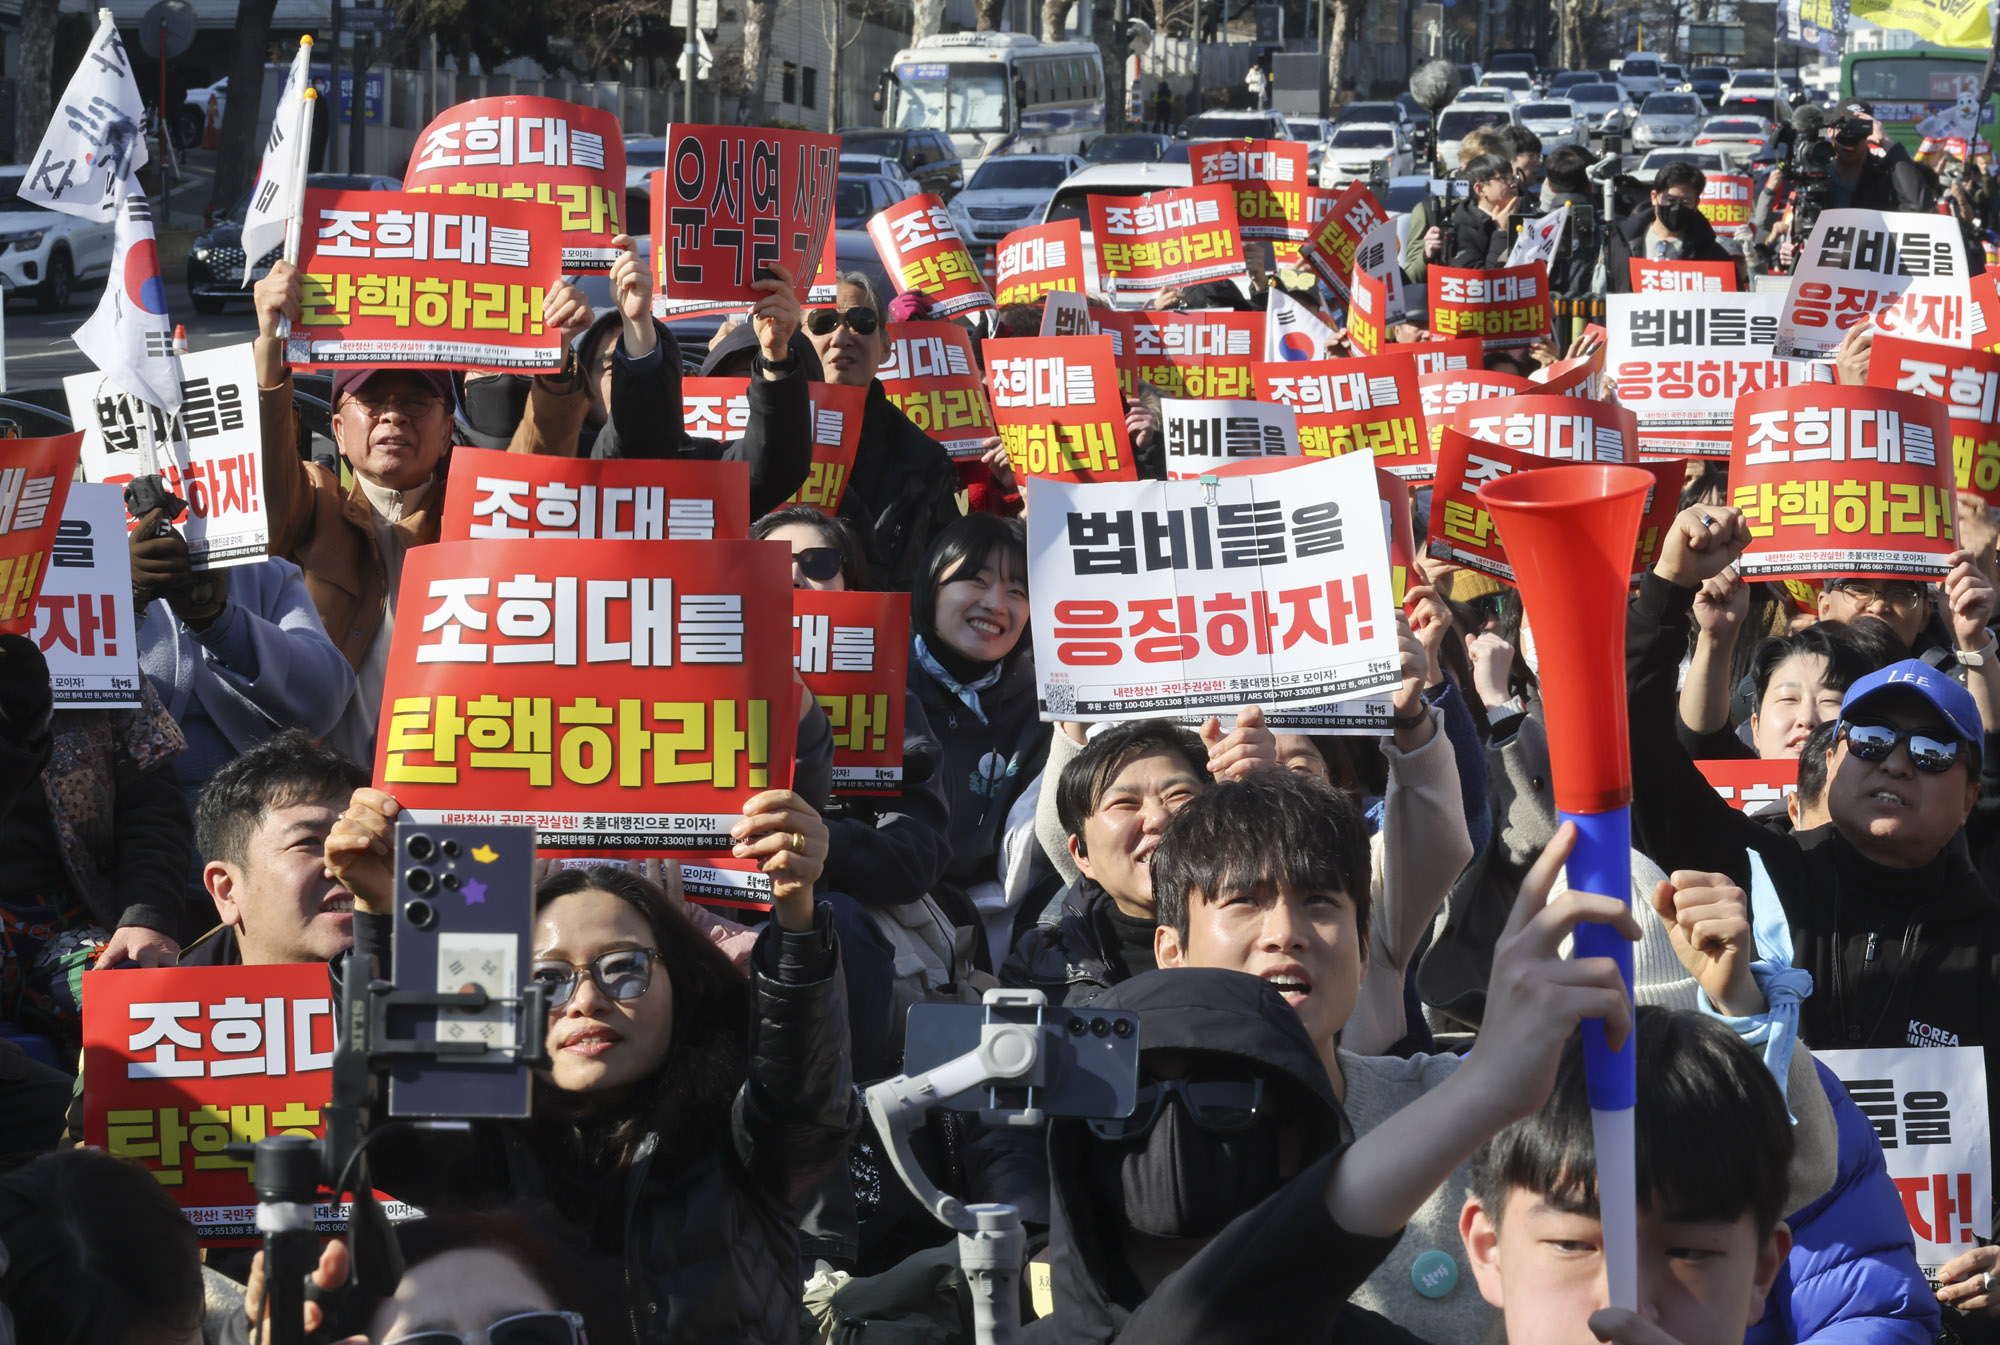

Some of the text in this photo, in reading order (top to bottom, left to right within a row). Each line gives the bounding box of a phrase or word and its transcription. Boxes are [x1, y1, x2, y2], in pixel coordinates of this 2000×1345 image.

[416, 116, 605, 170] 조희대를
[1201, 152, 1294, 184] 조희대를
[1233, 190, 1300, 222] 하라!
[1698, 181, 1748, 200] 희대를
[671, 136, 781, 287] 윤석열
[1105, 198, 1220, 235] 조희대를
[316, 209, 530, 267] 조희대를
[1103, 229, 1234, 272] 탄핵하라!
[1817, 226, 1954, 277] 법비들을
[301, 273, 544, 335] 탄핵하라!
[1441, 276, 1537, 303] 조희대를
[1434, 304, 1545, 336] 탄핵하라!
[1629, 308, 1777, 348] 법비들을
[1791, 282, 1963, 340] 응징하자!
[875, 337, 970, 380] 희대를
[1133, 323, 1250, 356] 조희대를
[991, 357, 1096, 407] 조희대를
[1268, 372, 1400, 414] 조희대를
[1617, 361, 1788, 400] 응징하자!
[886, 389, 991, 431] 하라!
[1169, 416, 1287, 457] 법비들을
[1299, 417, 1419, 459] 핵하라!
[1745, 406, 1936, 466] 조희대를
[469, 476, 714, 540] 조희대를
[1734, 479, 1954, 540] 탄핵하라!
[1067, 500, 1344, 576] 법비들을
[1902, 553, 1927, 562] 모이자!
[416, 573, 744, 666] 조희대를
[1053, 573, 1374, 666] 응징하자!
[56, 678, 84, 687] 모이자!
[1087, 702, 1102, 711] 후원
[1107, 702, 1123, 711] 신한
[1124, 698, 1182, 710] 100-036-551308
[1184, 692, 1241, 705] 촛불승리전환행동
[1247, 692, 1263, 700] ARS
[1263, 687, 1321, 699] 060-707-3300(한
[1113, 685, 1158, 698] 내란청산!
[1161, 681, 1226, 695] 국민주권실현!
[1229, 674, 1301, 690] 촛불대행진으로
[1303, 669, 1337, 683] 모이자!
[1887, 669, 1931, 689] LEE
[384, 694, 769, 788] 탄핵하라!
[535, 833, 595, 846] 불승리전환행동
[603, 836, 622, 845] ARS
[624, 836, 695, 846] 060-707-3300(한
[696, 837, 713, 846] 통에
[714, 837, 727, 846] 1만
[582, 816, 670, 831] 촛불대행진으로
[673, 817, 717, 831] 모이자!
[682, 868, 716, 881] 모이자!
[351, 1000, 364, 1052] SLIK
[1908, 1019, 1960, 1047] KOREA
[315, 1224, 331, 1232] ARS
